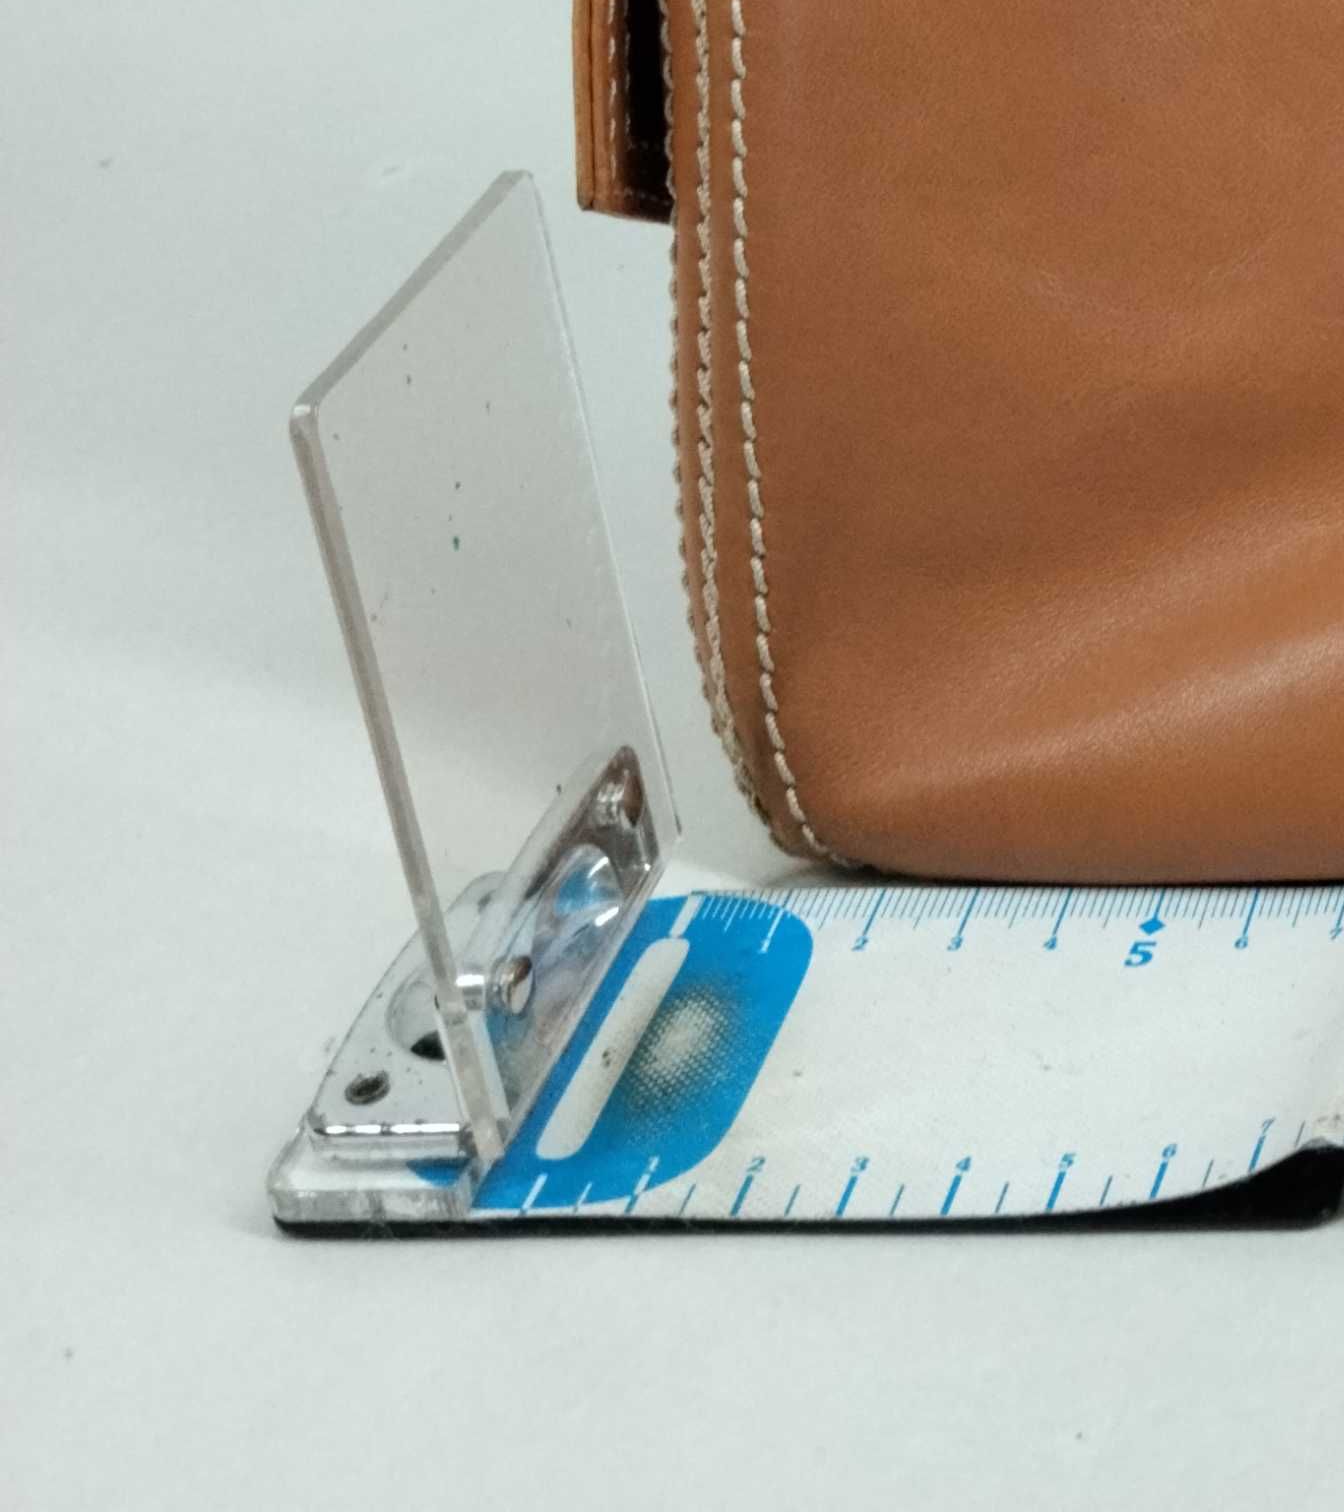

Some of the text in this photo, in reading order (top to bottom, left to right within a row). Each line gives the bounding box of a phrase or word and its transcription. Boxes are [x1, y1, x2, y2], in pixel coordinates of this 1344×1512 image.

[851, 936, 868, 951] 2
[947, 936, 963, 951] 3
[1043, 936, 1058, 951] 4
[1124, 940, 1156, 967] 5
[1235, 936, 1249, 950] 6
[747, 1156, 766, 1173] 2
[850, 1156, 870, 1173] 3
[955, 1156, 973, 1172] 4
[1059, 1152, 1076, 1170] 5
[1160, 1143, 1178, 1160] 6
[1261, 1117, 1276, 1134] 7
